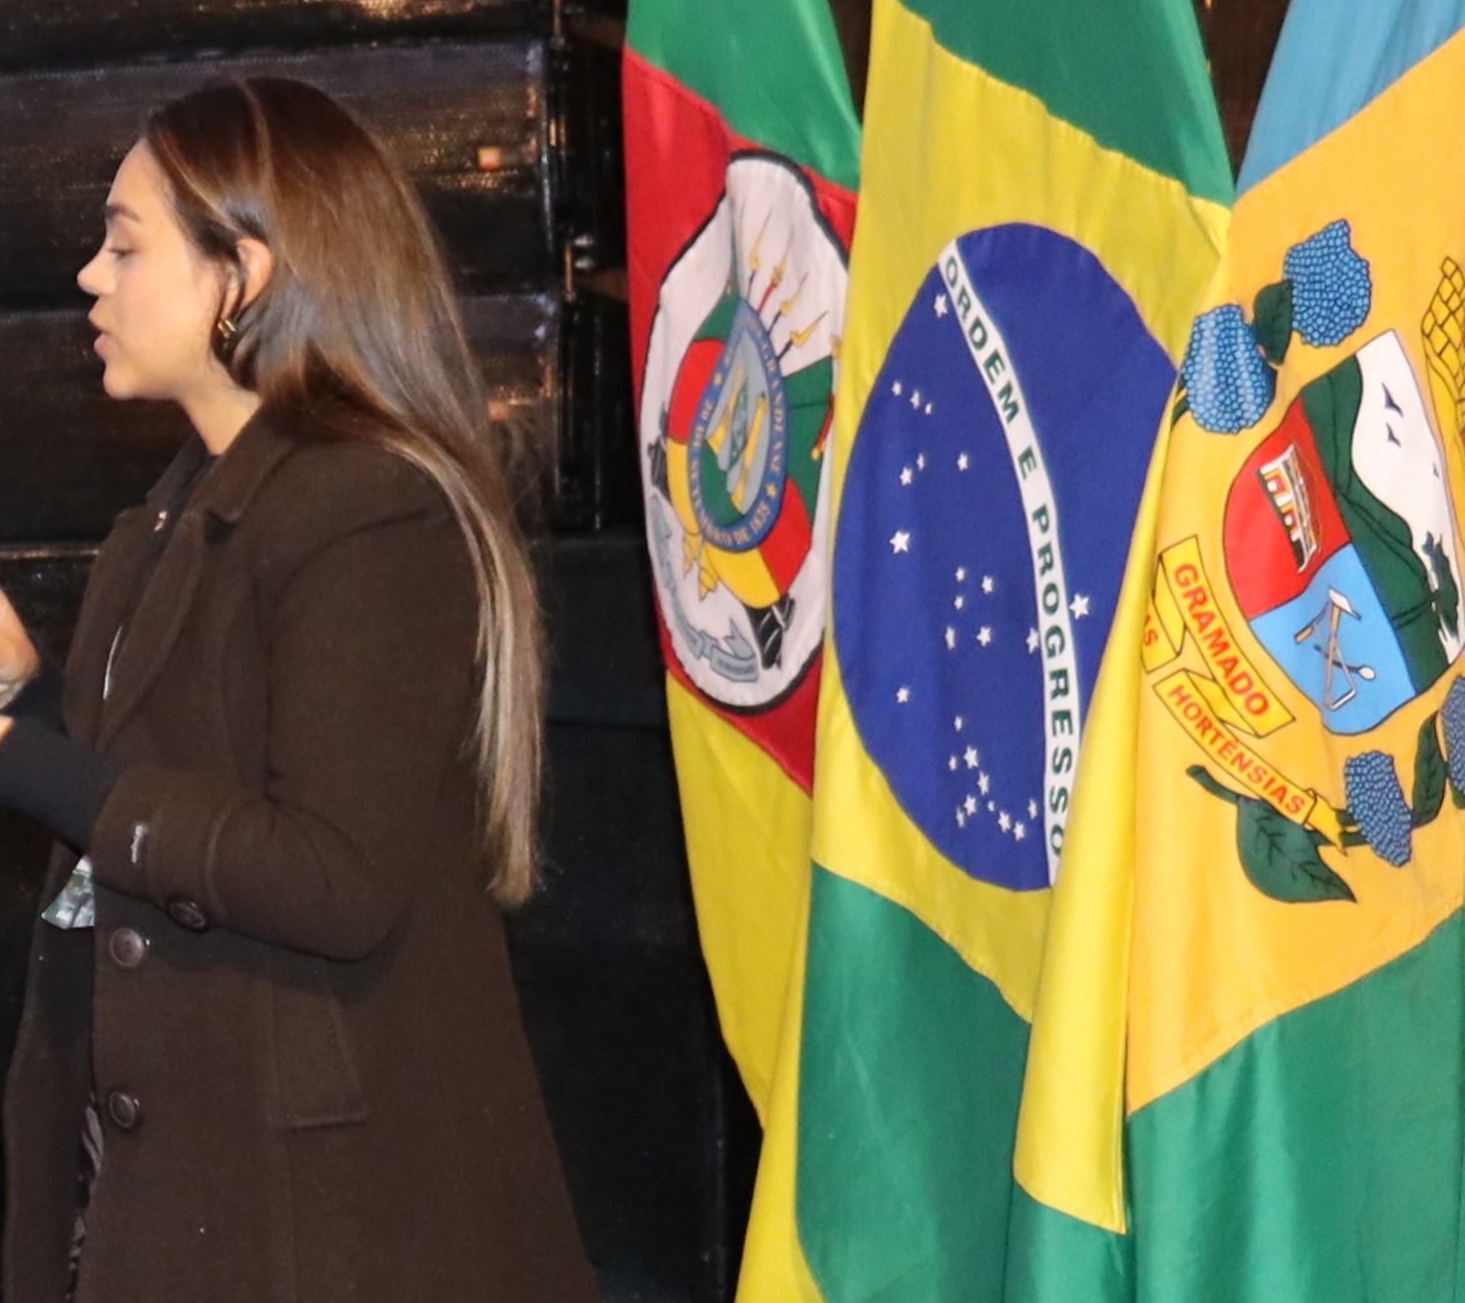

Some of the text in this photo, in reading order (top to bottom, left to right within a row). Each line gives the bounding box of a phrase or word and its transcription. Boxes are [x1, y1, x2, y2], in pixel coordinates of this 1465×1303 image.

[944, 255, 1074, 856] ORDEM E PROGRESSO
[1174, 563, 1270, 717] GRAMADO
